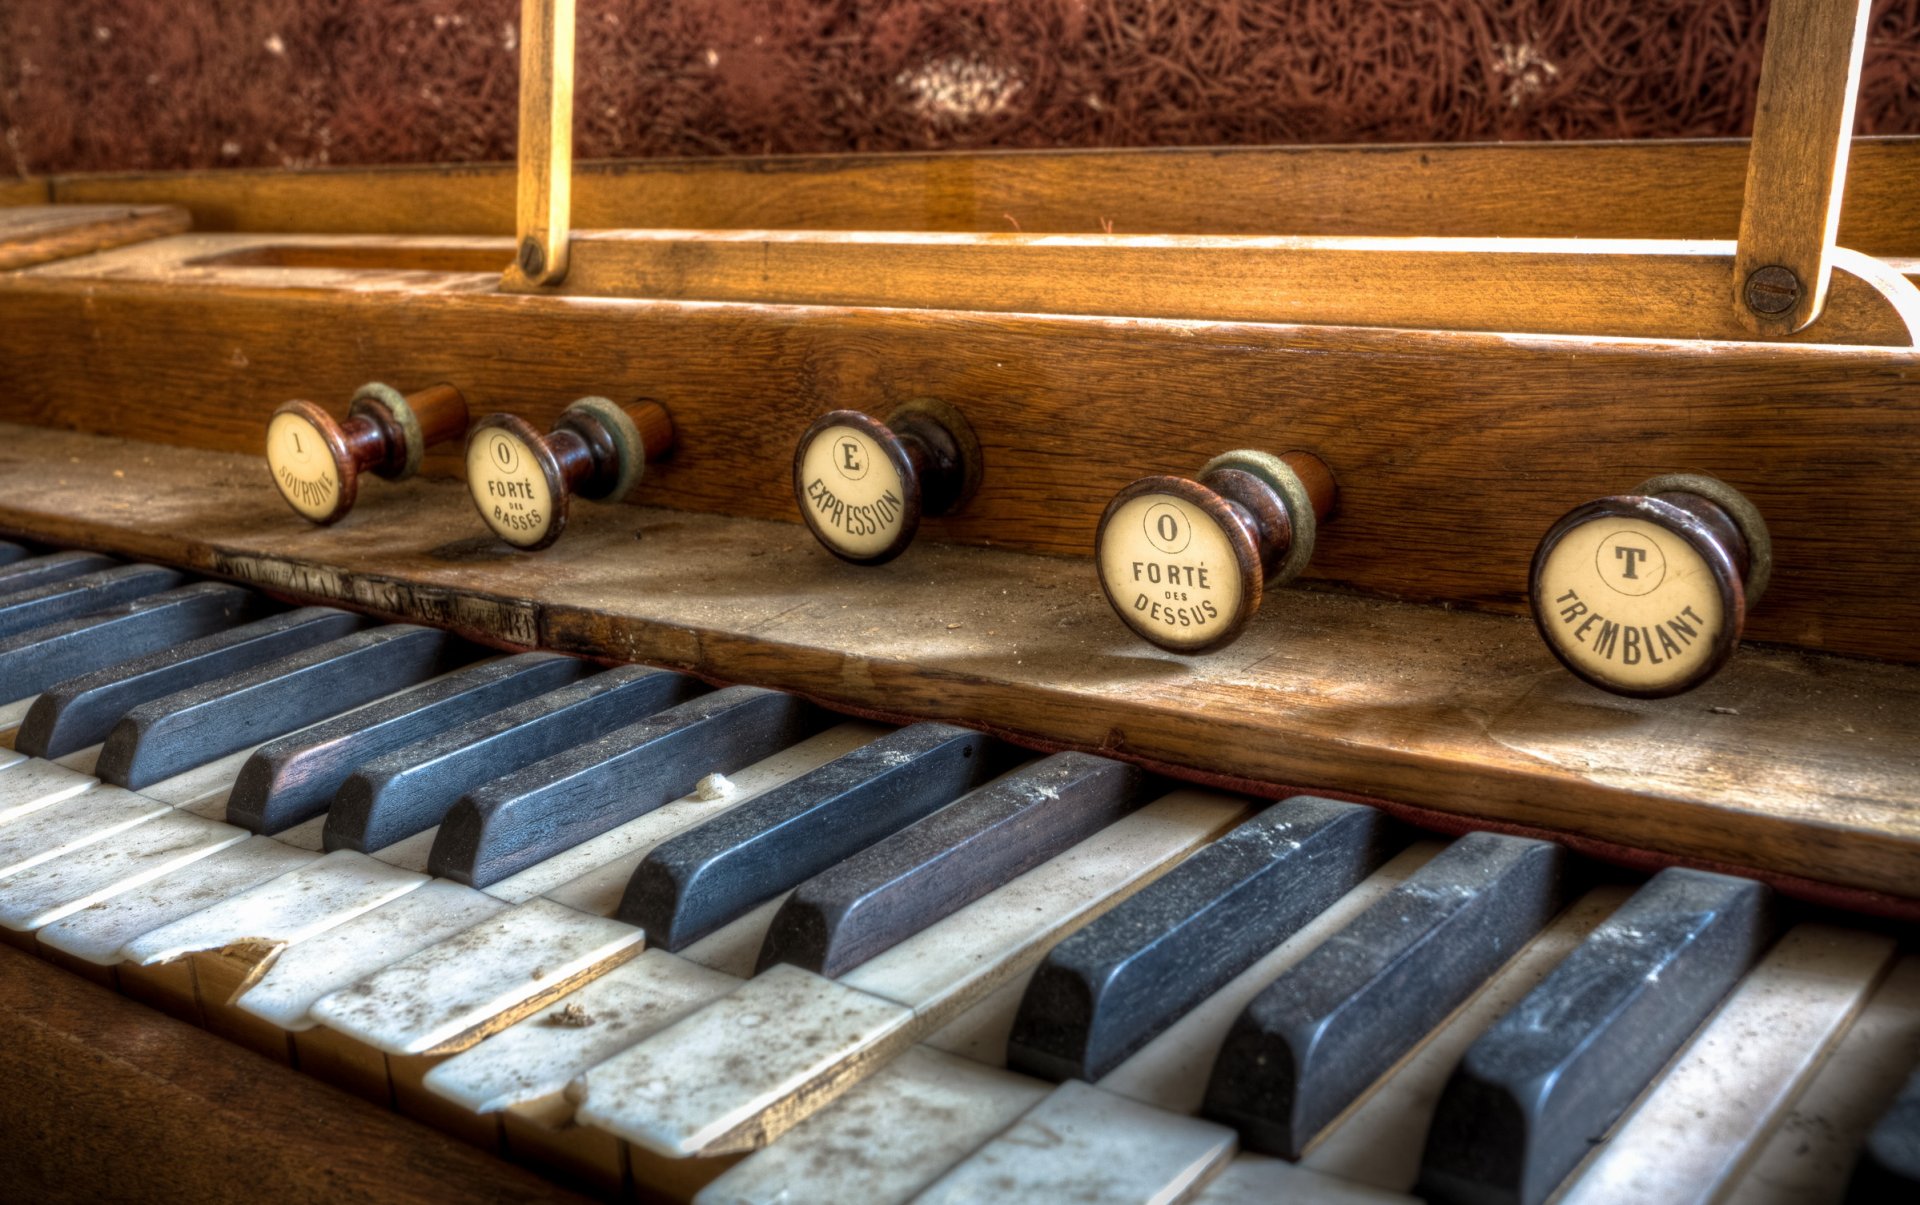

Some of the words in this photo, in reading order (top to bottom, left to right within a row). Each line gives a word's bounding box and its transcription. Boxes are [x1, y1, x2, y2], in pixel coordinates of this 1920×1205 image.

[841, 443, 861, 472] E
[279, 465, 334, 507] SOURDINE
[494, 505, 543, 531] BASSES
[807, 478, 903, 537] EXPRESSION
[1132, 561, 1212, 590] FORTÉ
[1615, 546, 1648, 580] T
[1134, 593, 1219, 628] DESSUS
[1164, 591, 1189, 601] DES
[1556, 588, 1706, 666] TREMBLANT
